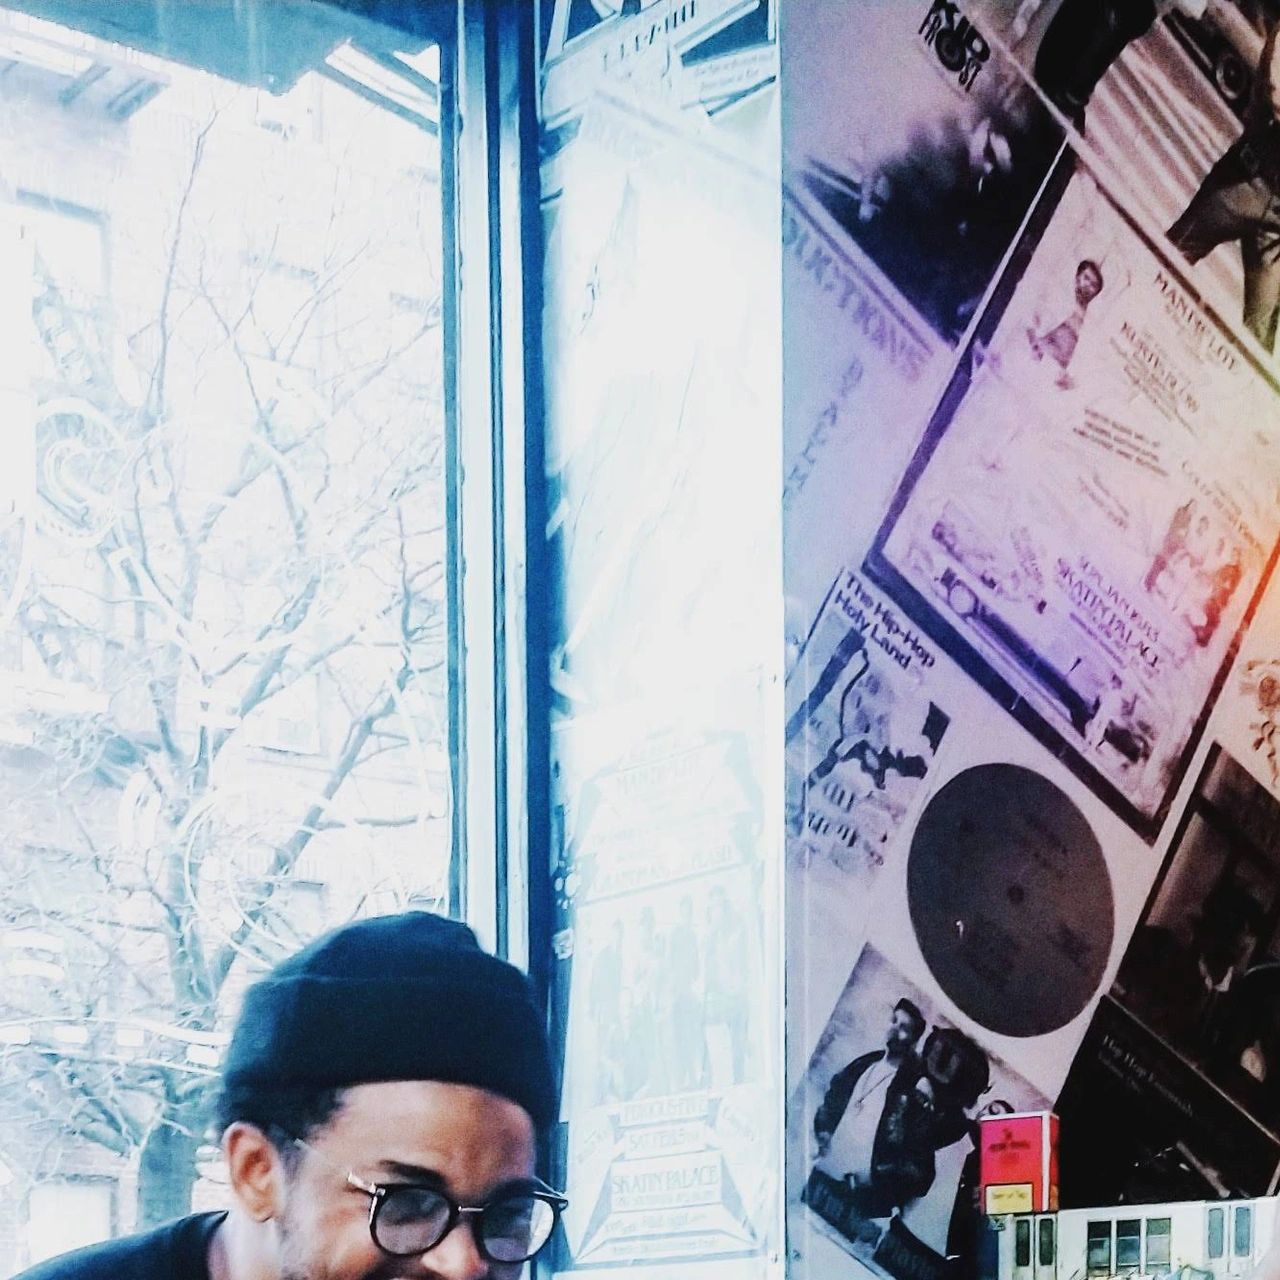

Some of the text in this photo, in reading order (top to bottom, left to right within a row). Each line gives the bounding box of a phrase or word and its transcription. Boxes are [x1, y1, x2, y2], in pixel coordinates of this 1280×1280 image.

[833, 588, 913, 672] Holy Land
[845, 575, 936, 669] The Hip-Hop
